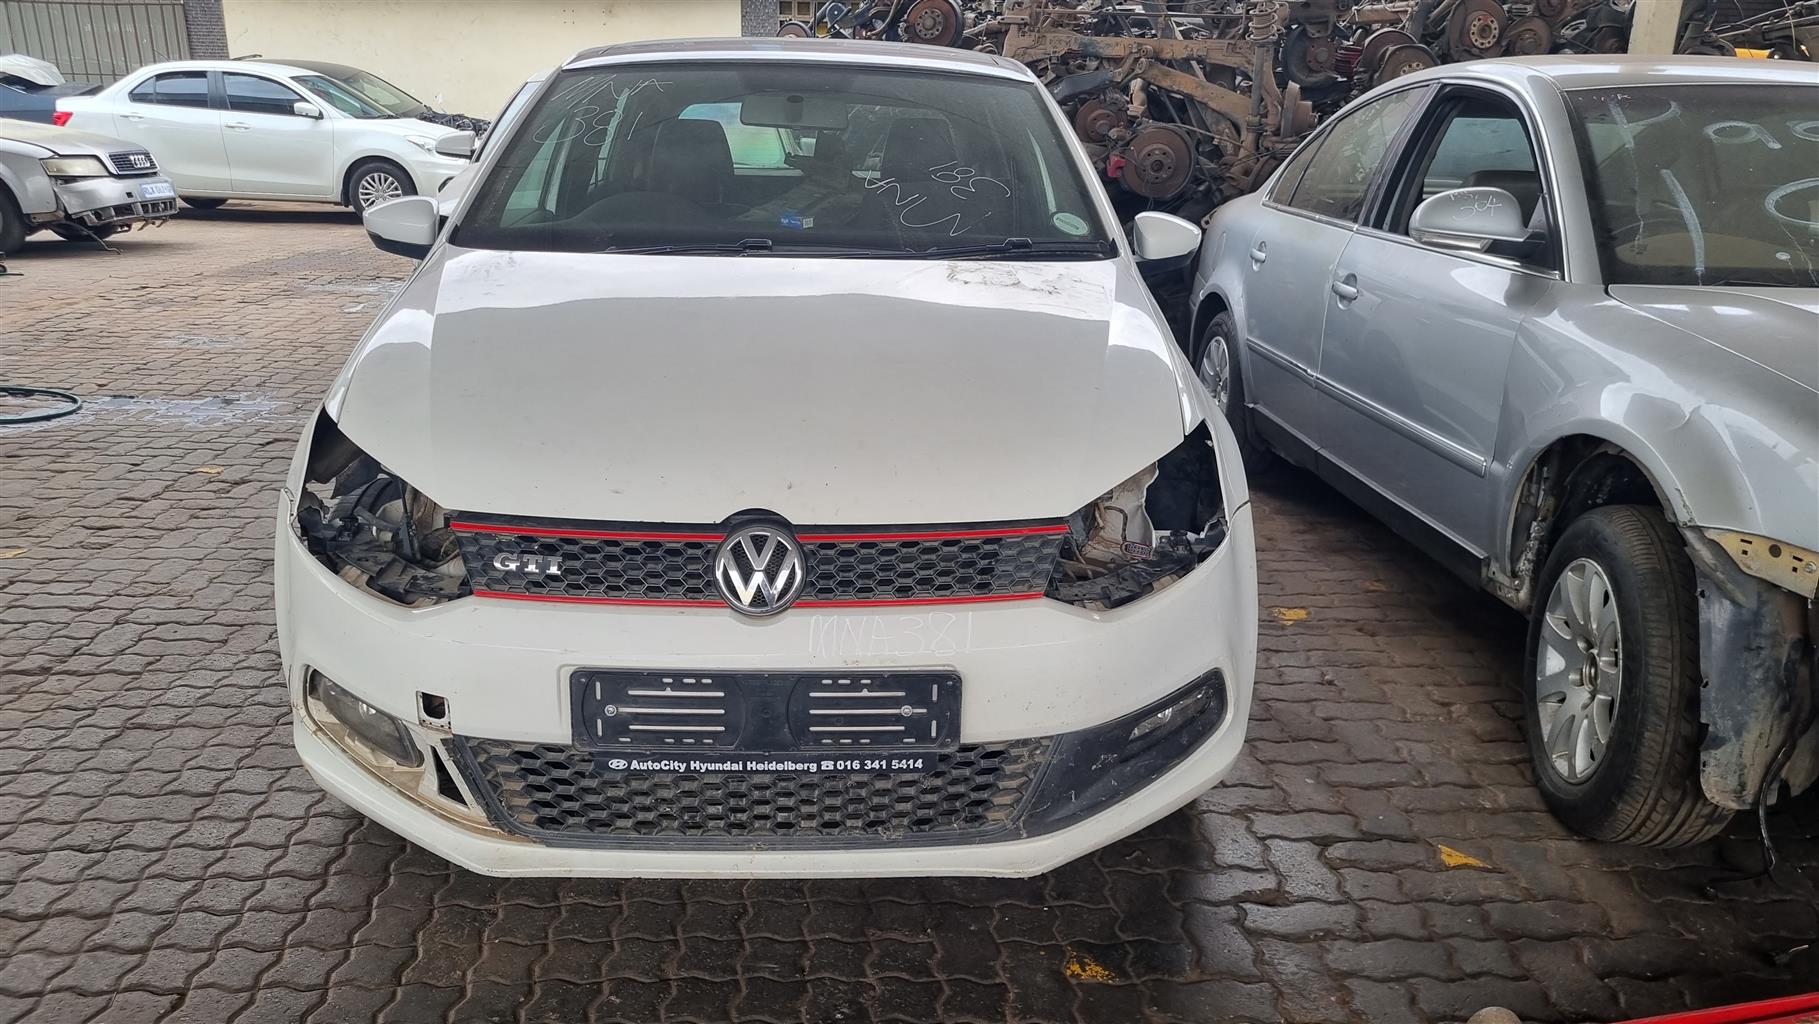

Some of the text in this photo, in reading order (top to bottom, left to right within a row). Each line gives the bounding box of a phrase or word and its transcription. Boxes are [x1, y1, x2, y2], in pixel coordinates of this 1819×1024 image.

[492, 552, 563, 576] GTI
[630, 758, 923, 773] AutoCity Hyundai Heidelberg 016 341 5414
